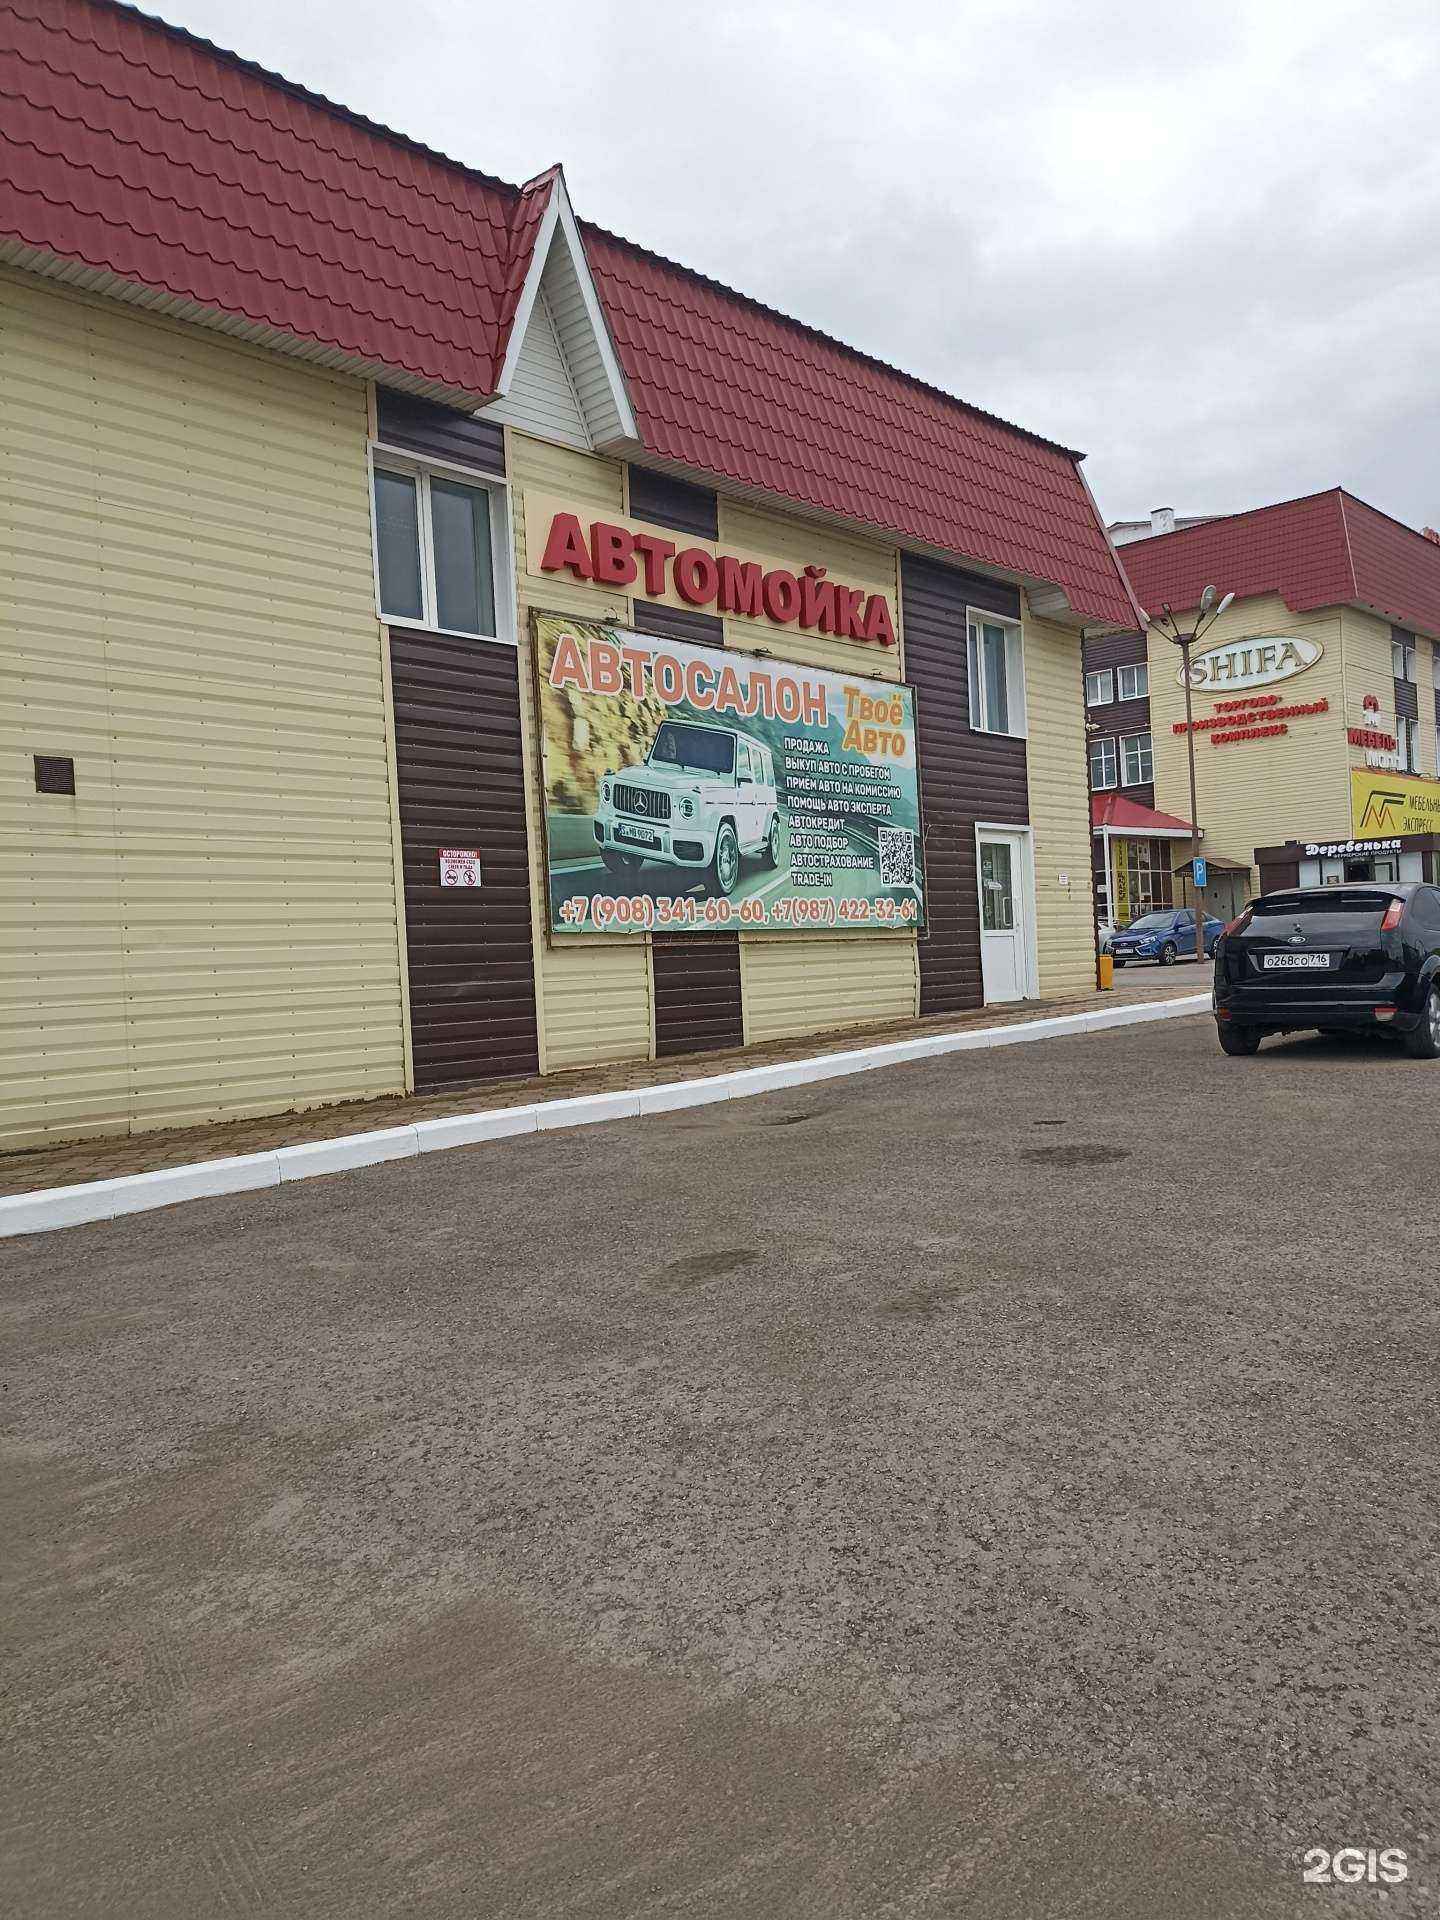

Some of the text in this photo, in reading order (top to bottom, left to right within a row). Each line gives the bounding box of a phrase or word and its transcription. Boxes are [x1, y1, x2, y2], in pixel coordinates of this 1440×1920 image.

[540, 512, 895, 646] АВТОМОЙКА
[1188, 642, 1307, 684] SHIFA
[549, 634, 829, 727] АВТОСАЛОН
[1211, 723, 1288, 745] КОМПЛЕКС
[1347, 728, 1396, 751] МЕБЕЛЬ
[784, 737, 829, 755] ПРОДАЖА
[785, 756, 891, 781] ВЫКУП АВТО С ПРОБЕГОМ
[818, 780, 840, 793] АВТО
[842, 783, 854, 795] НА
[855, 784, 901, 800] КОМИССИЮ
[787, 795, 892, 816] ПОМОЩЬ АВТО ЭКСПЕРТА
[788, 815, 845, 831] АВТОКРЕДИТ
[790, 834, 849, 851] АВТО ПОДБОР
[1305, 840, 1401, 857] Деревенька
[443, 850, 477, 858] ОСТОРОЖНО!
[790, 853, 874, 869] АВТОСТРАХОВАНИЕ
[791, 872, 833, 886] TRADE-IN
[560, 894, 917, 927] +7 (908) 341-60-60, +7(987) 422-32-61
